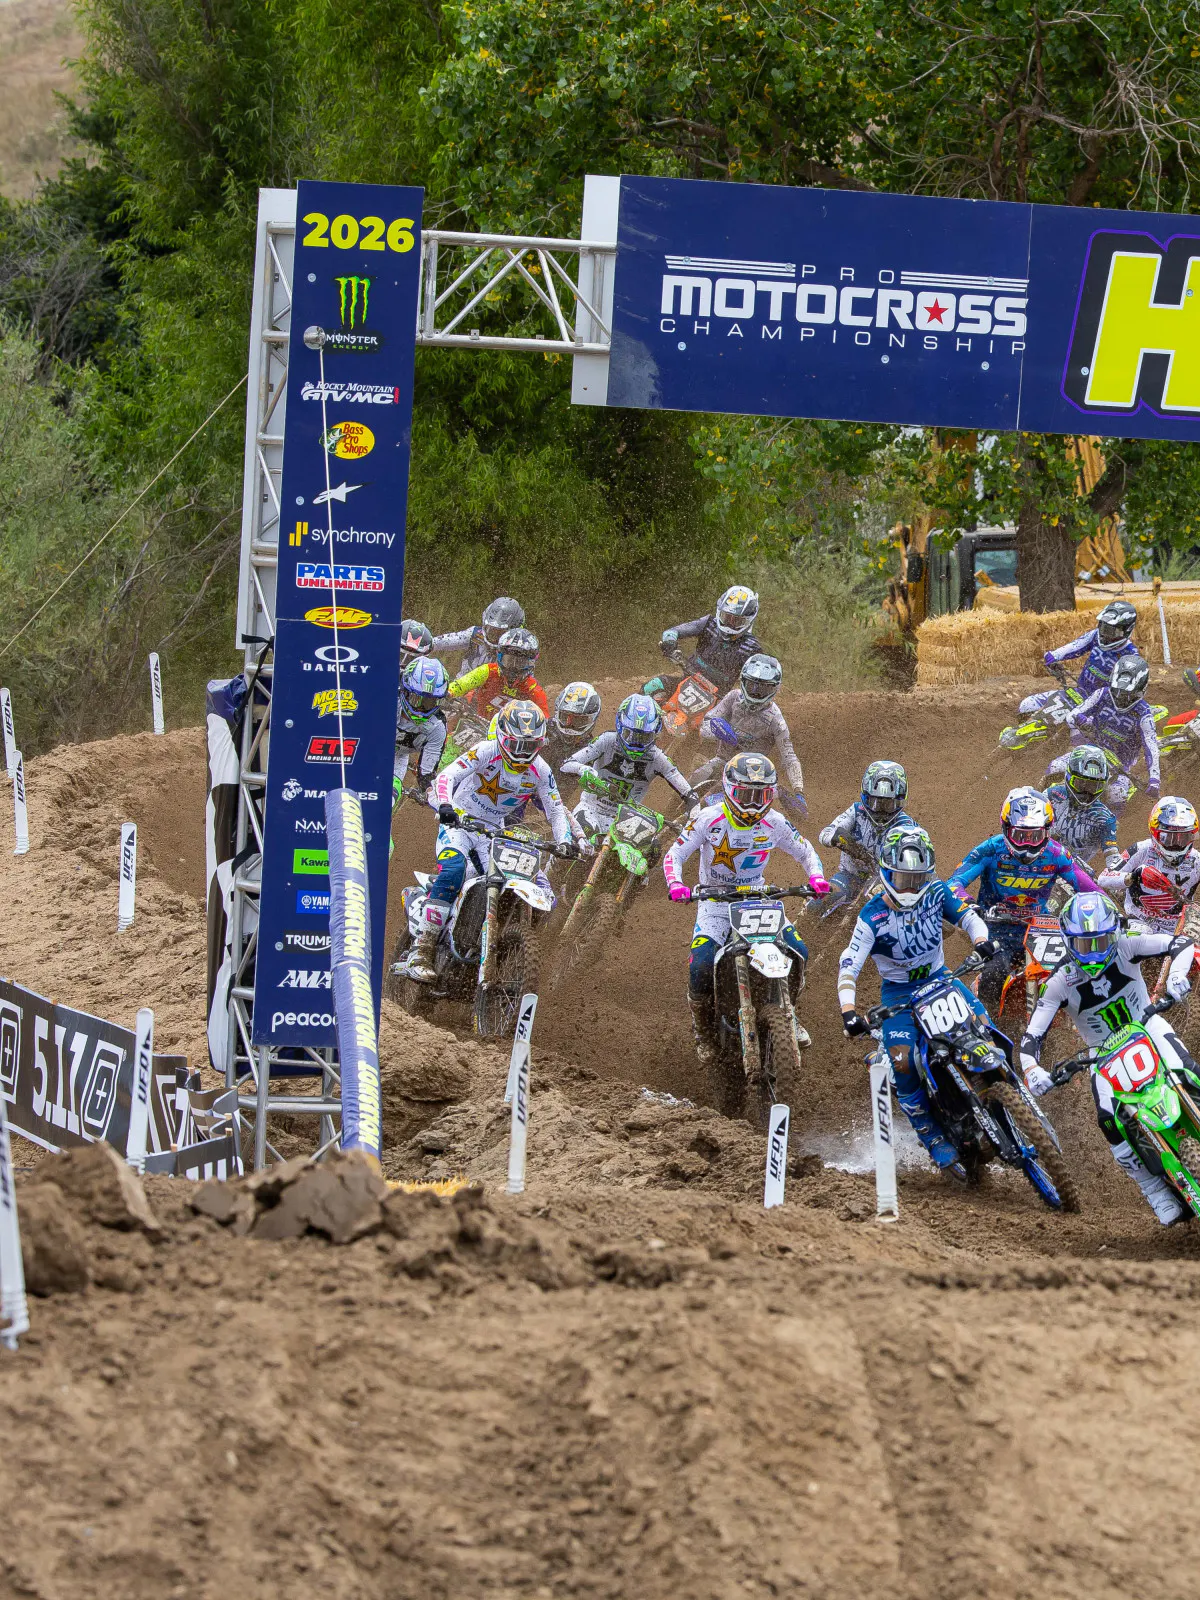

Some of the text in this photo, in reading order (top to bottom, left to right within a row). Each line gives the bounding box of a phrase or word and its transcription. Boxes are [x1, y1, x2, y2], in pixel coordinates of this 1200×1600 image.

[302, 212, 415, 253] 2026
[801, 264, 895, 284] PRO
[660, 274, 1029, 337] MOTOCROSS
[326, 333, 378, 345] MONSTER
[660, 318, 1027, 355] CHAMPIONSHIP
[346, 382, 394, 393] MOUNTAIN
[343, 423, 364, 435] Bass
[343, 434, 359, 444] Pro
[342, 443, 368, 456] Shops
[311, 526, 396, 549] synchrony
[297, 563, 384, 581] PARTS
[297, 578, 384, 591] UNLIMITED
[302, 662, 369, 674] OAKLEY
[313, 689, 353, 708] MOTO
[318, 699, 358, 718] TEES
[677, 684, 711, 713] 57
[310, 739, 356, 755] ETS
[304, 790, 378, 801] MAES
[341, 792, 365, 874] HOLESHOT
[615, 814, 658, 845] 47
[122, 845, 132, 881] UFO
[498, 847, 538, 877] 58
[344, 879, 366, 960] HOLESHOT
[738, 908, 783, 935] 59
[1033, 936, 1067, 963] 13
[350, 966, 377, 1054] HOLESHOT
[921, 991, 969, 1036] 180
[32, 1015, 88, 1135] 5.11
[137, 1051, 151, 1106] UFO
[1029, 1071, 1042, 1090] FOX
[1107, 1043, 1156, 1093] 10
[358, 1060, 380, 1150] HOLESHOT
[877, 1097, 891, 1145] UFO
[769, 1135, 781, 1180] UFO
